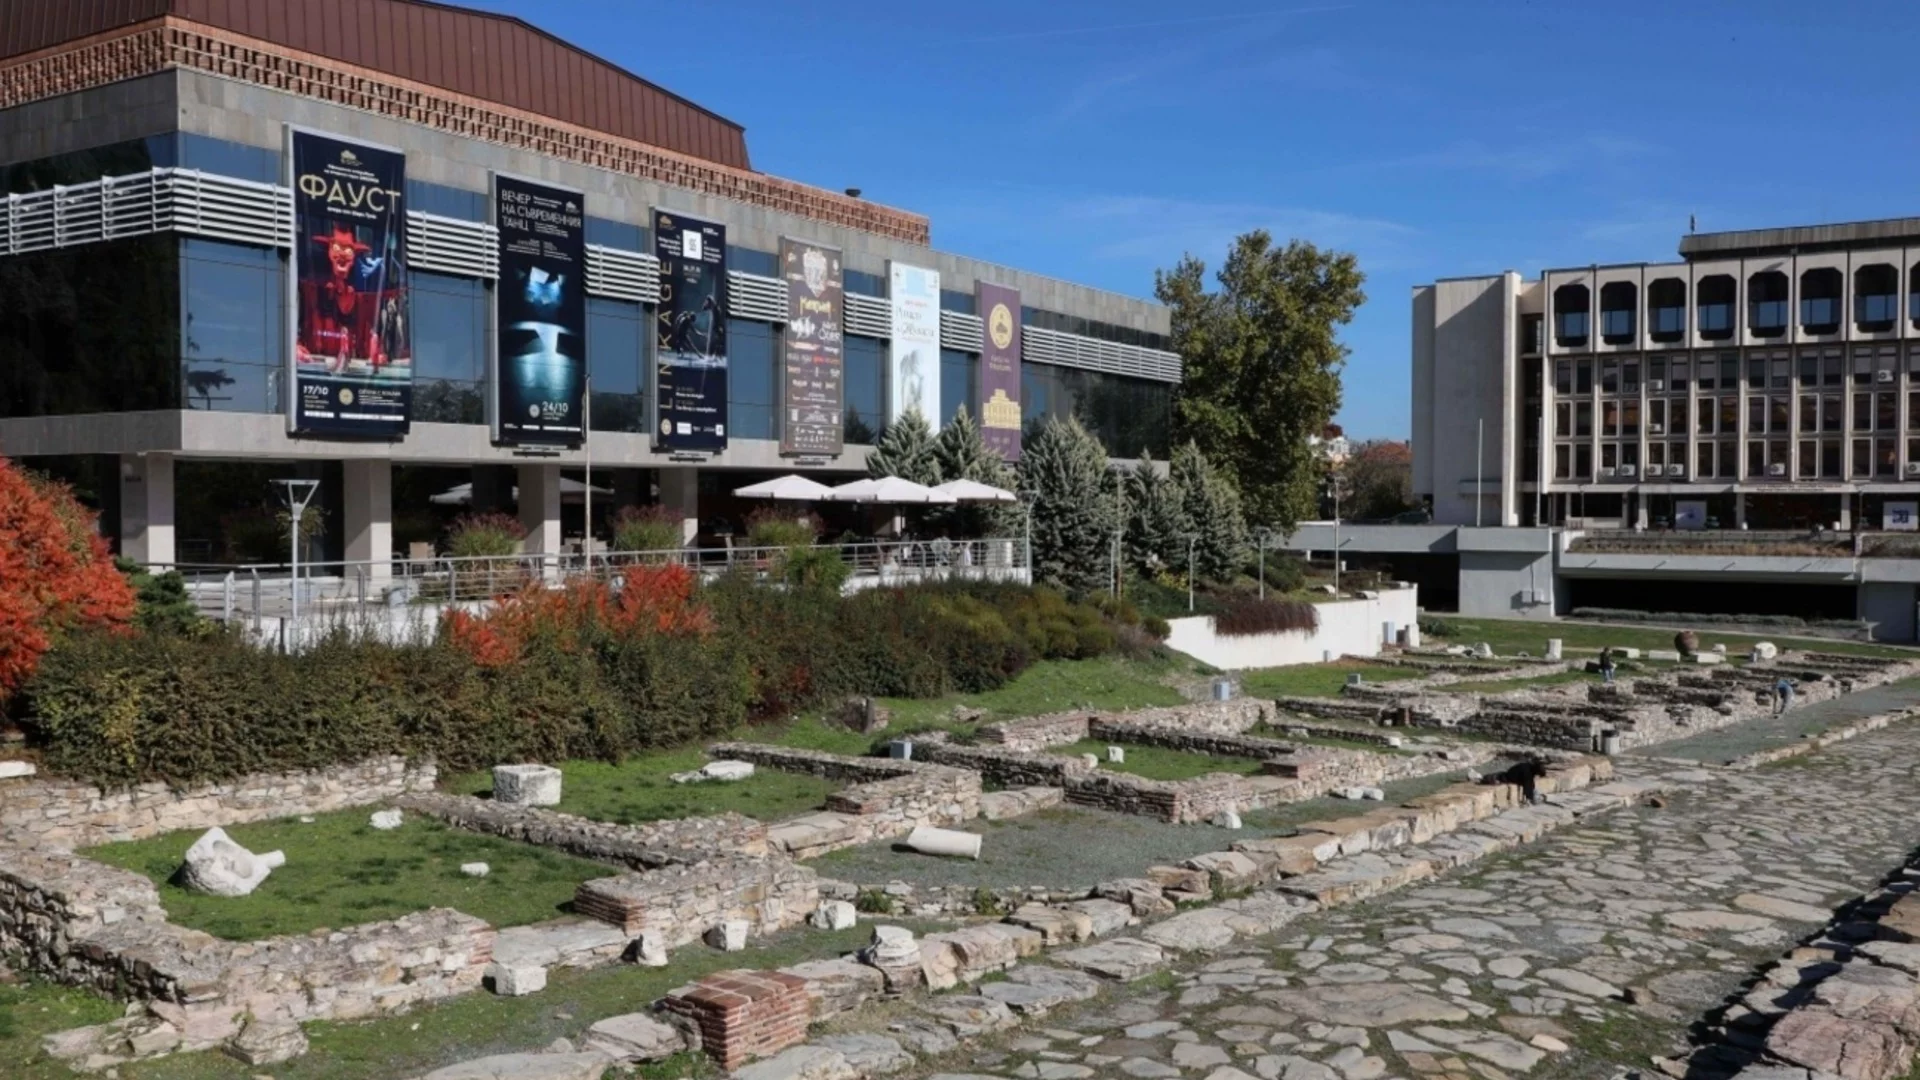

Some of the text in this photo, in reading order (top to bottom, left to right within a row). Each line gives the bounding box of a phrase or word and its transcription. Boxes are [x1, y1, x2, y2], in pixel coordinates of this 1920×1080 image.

[299, 174, 401, 214] ФАУСТ
[502, 189, 531, 205] ВЕЧЕР
[502, 203, 582, 229] НА СЪВРЕМЕННИЯ
[502, 215, 529, 232] ТАНЦ
[659, 261, 672, 409] LINKAGE
[303, 385, 329, 396] 17/10
[542, 401, 569, 414] 24/10
